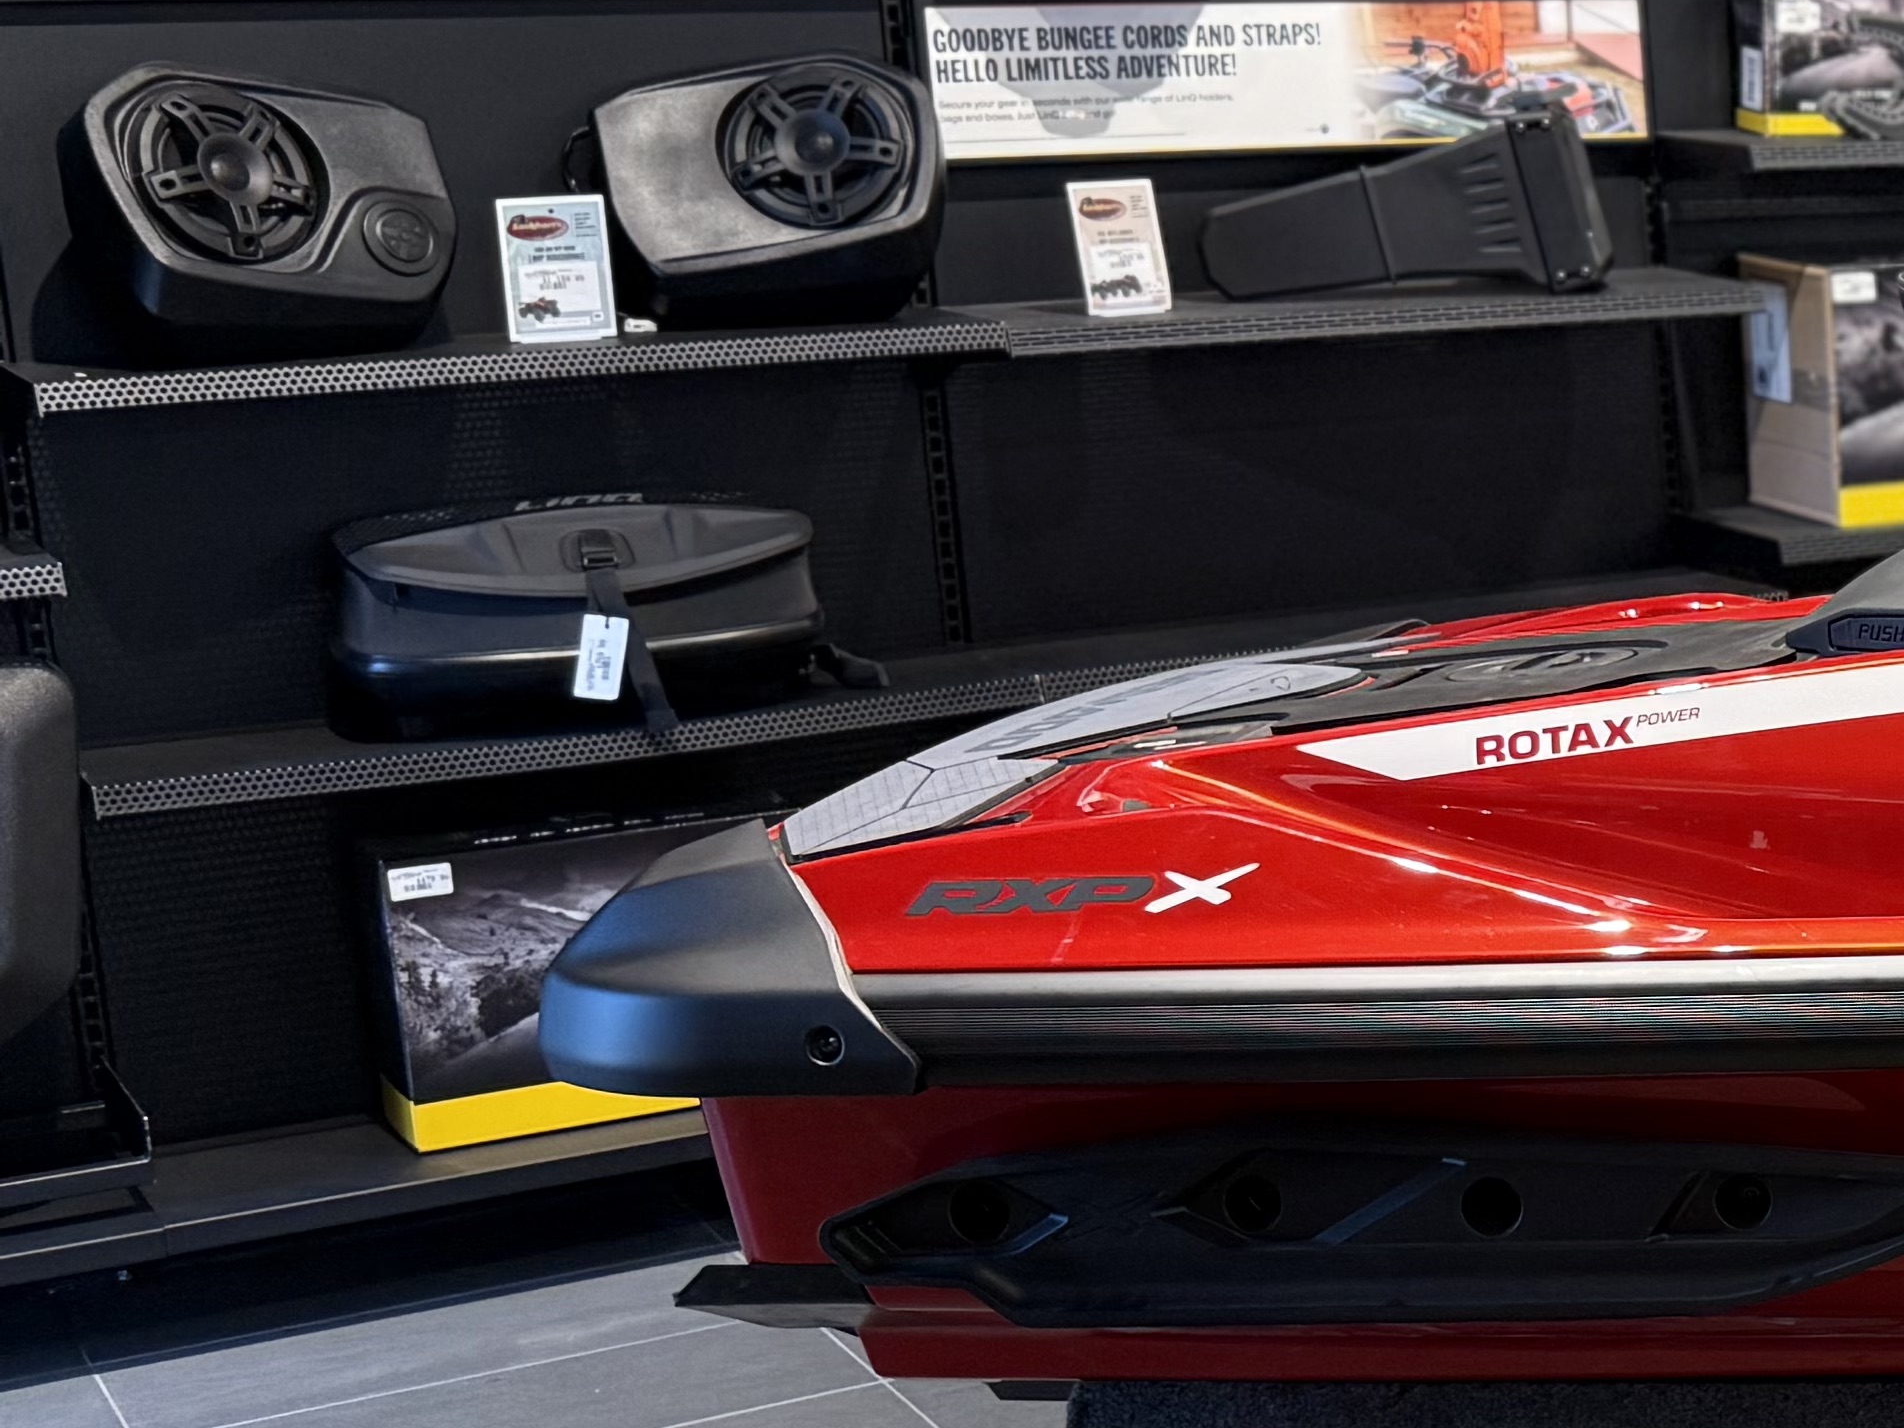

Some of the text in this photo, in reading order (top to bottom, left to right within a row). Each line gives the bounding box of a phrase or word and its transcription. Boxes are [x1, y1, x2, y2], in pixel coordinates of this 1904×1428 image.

[932, 22, 1322, 53] GOODBYE BUNGEE CORDS AND STRAPS!
[936, 52, 1237, 84] HELLO LIMITLESS ADVENTURE!
[938, 99, 973, 110] Secure
[975, 100, 995, 110] your
[997, 100, 1018, 109] gear
[1475, 707, 1701, 766] ROTAX POWER
